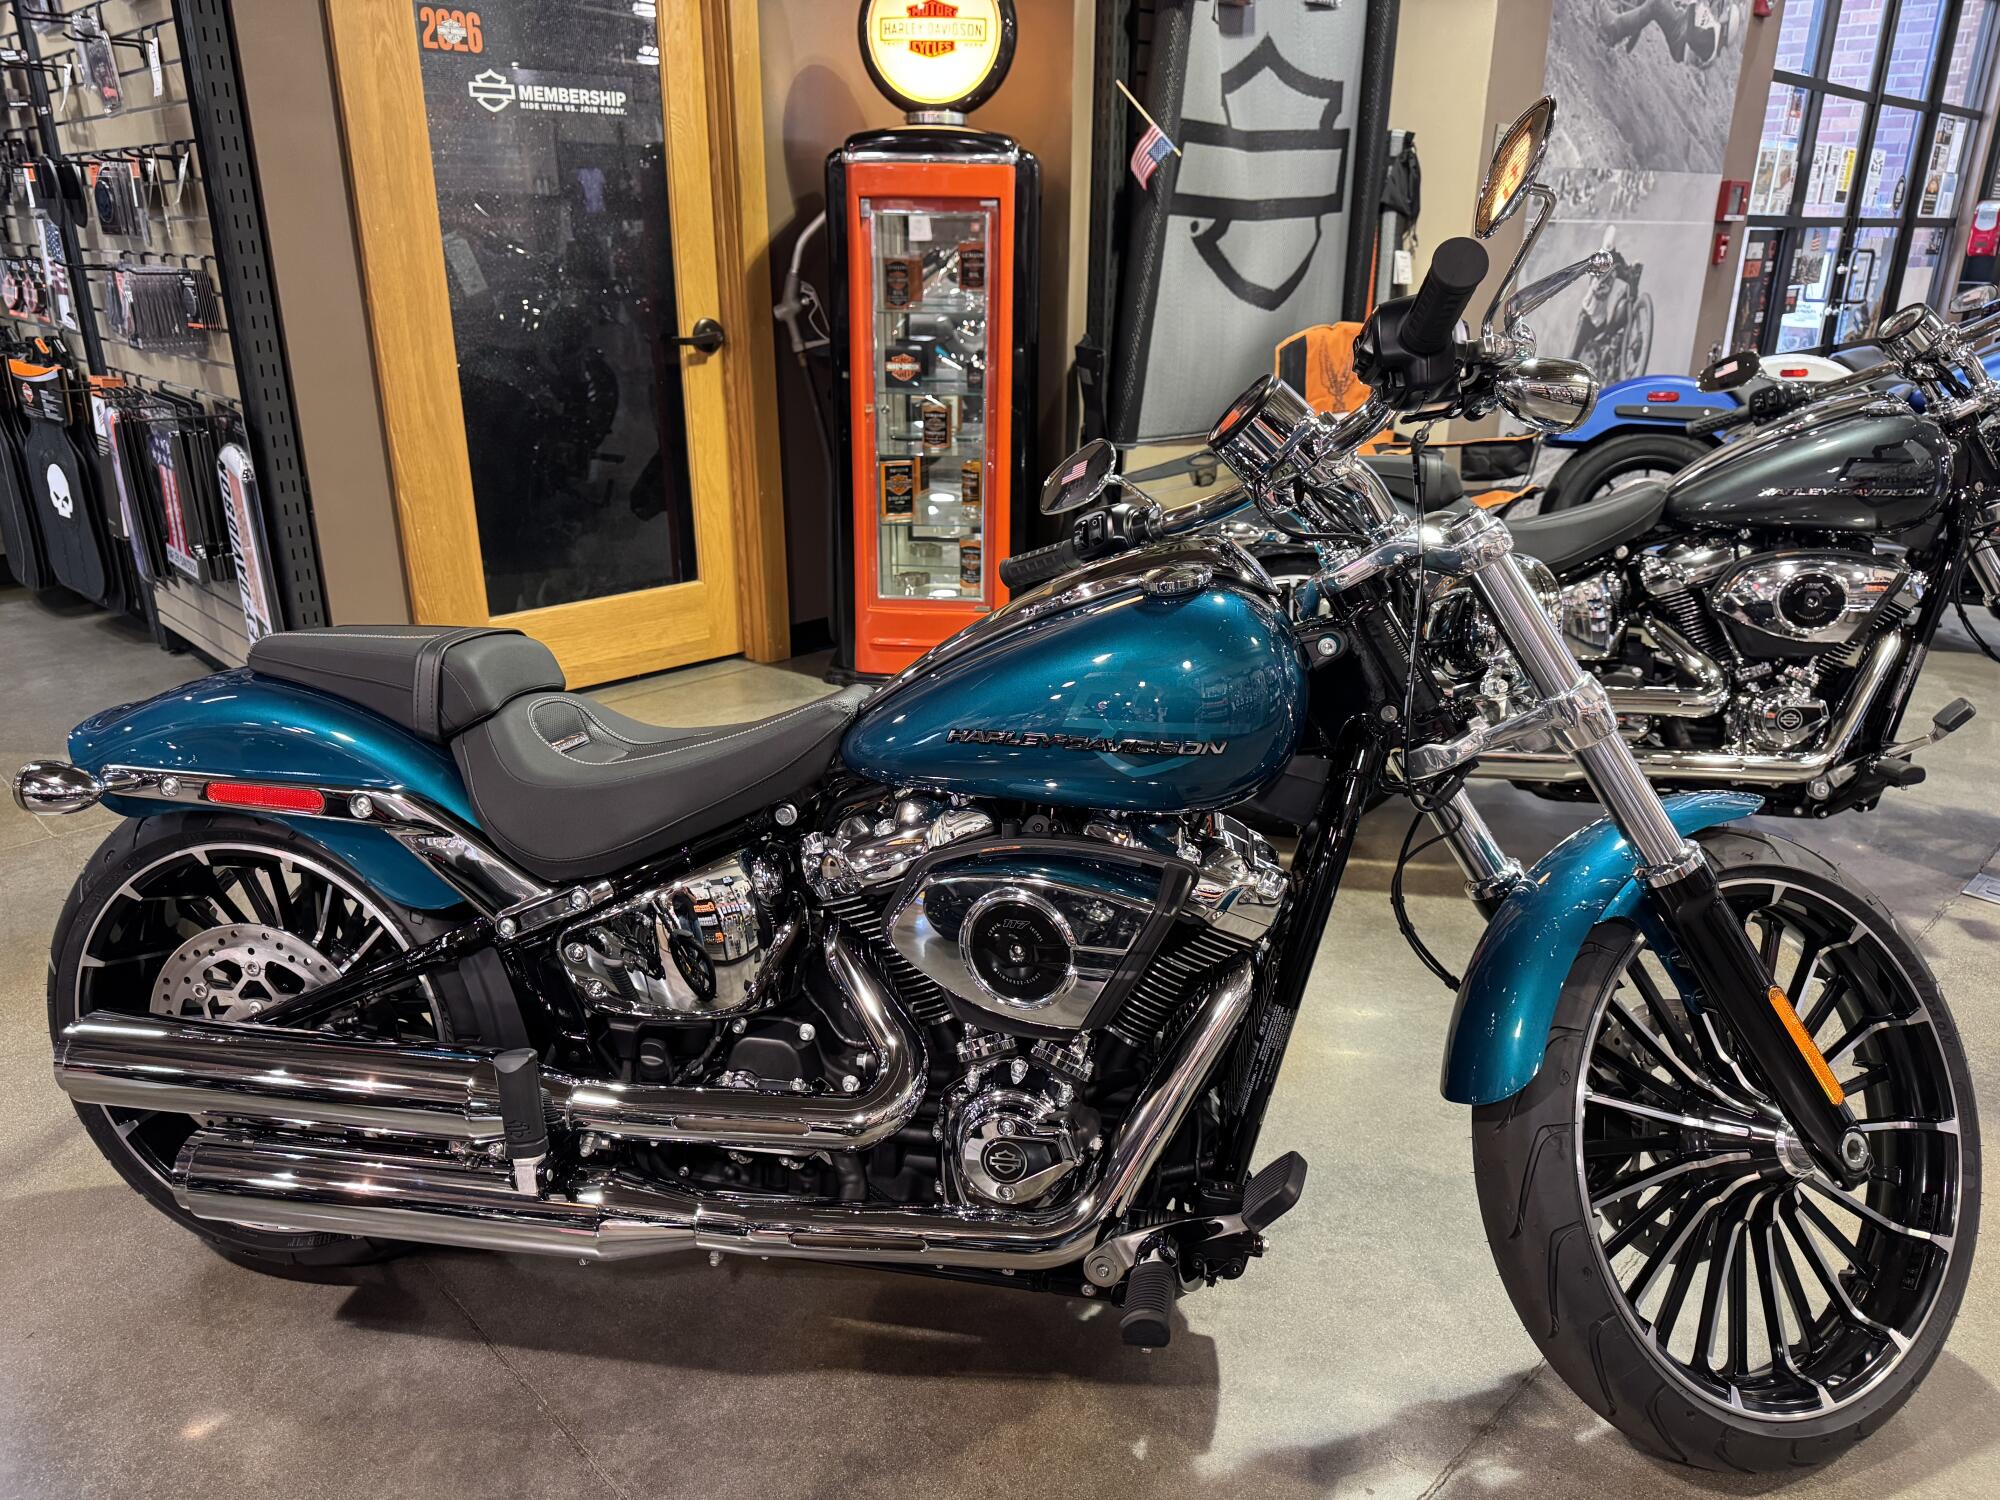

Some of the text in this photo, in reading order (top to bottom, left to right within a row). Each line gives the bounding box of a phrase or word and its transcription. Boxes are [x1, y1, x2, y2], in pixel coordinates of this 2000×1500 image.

[911, 41, 953, 57] CYCLES
[518, 85, 627, 107] MEMBERSHIP
[520, 102, 628, 116] RIDE WITH US. JOIN TODAY.
[946, 728, 1228, 755] HARLEY-DAVIDSON
[1002, 918, 1031, 930] 117
